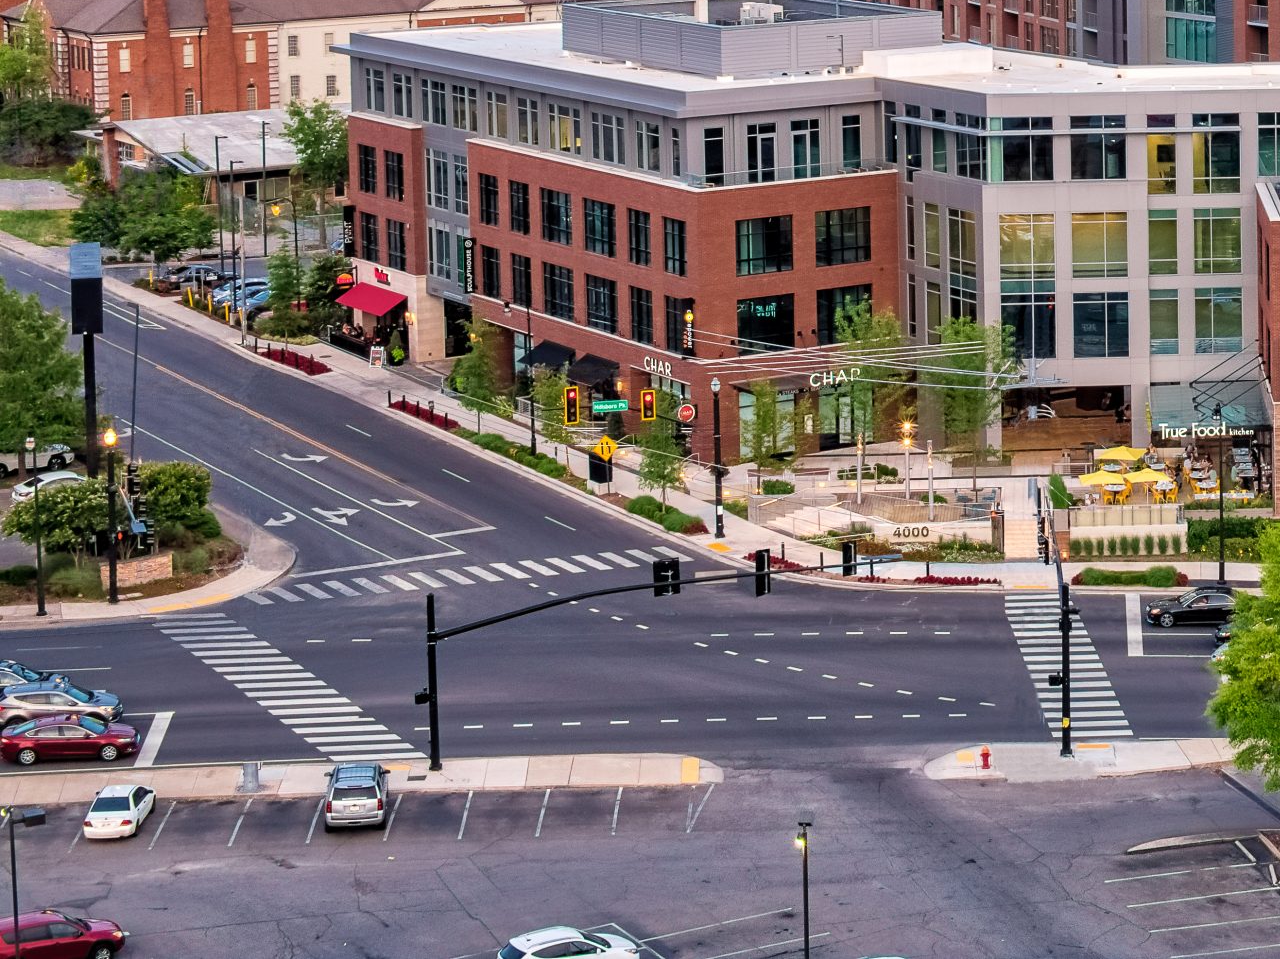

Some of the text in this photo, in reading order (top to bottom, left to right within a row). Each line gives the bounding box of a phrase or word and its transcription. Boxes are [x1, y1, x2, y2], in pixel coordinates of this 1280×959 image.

[644, 356, 672, 377] CHAR
[1159, 423, 1187, 439] True
[1192, 421, 1226, 438] Food
[893, 526, 929, 538] 4000
